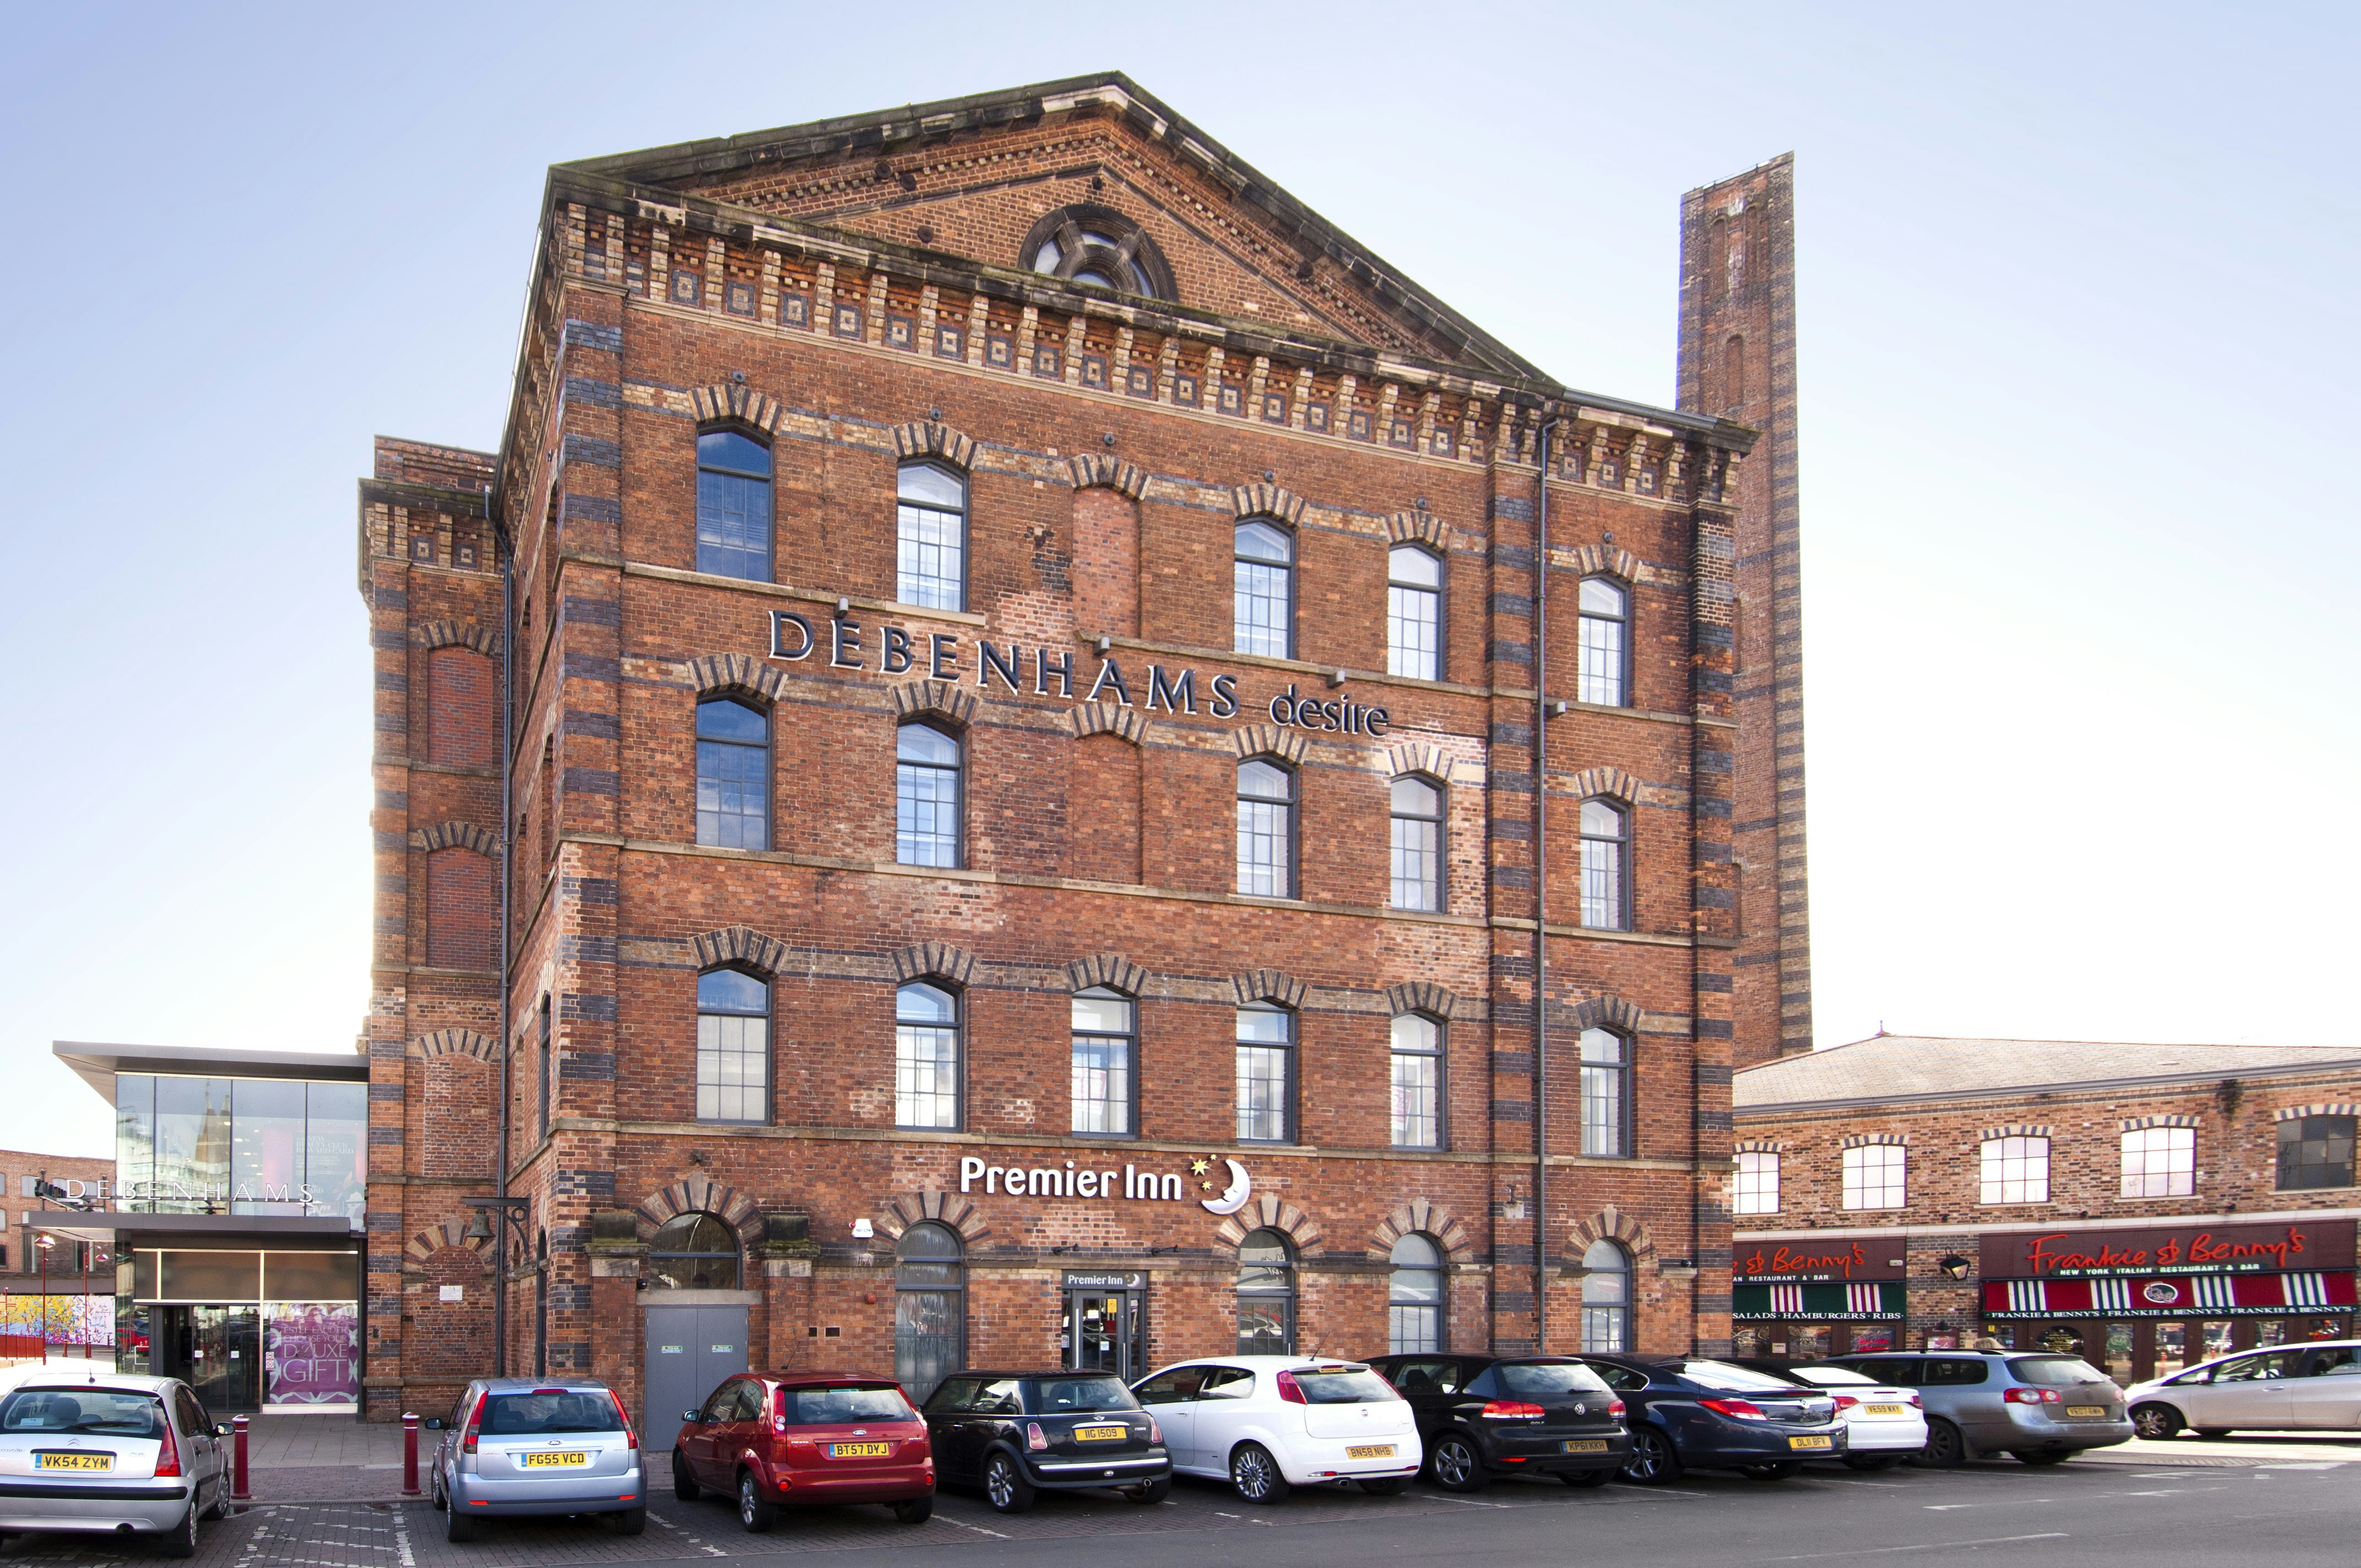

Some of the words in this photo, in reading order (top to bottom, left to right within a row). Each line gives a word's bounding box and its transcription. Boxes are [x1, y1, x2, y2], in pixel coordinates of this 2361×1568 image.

[769, 610, 1240, 719] DEBENHAMS
[1270, 683, 1391, 738] desire
[960, 1157, 1118, 1198] Premier
[1126, 1164, 1182, 1200] Inn
[66, 1179, 313, 1202] DEBENHAMS
[2026, 1233, 2148, 1274] Frankie
[2156, 1237, 2181, 1266] &
[2188, 1226, 2306, 1267] Benny's
[1746, 1250, 1765, 1275] &
[1771, 1242, 1866, 1278] Benny's
[1068, 1275, 1107, 1284] Premier
[1108, 1276, 1123, 1285] Inn
[283, 1359, 347, 1382] GIFT
[1098, 1428, 1118, 1438] 1509
[1568, 1442, 1588, 1450] KP61
[1590, 1441, 1605, 1450] KKH
[1797, 1438, 1811, 1447] DL11
[1813, 1438, 1826, 1446] BFV
[836, 1444, 864, 1455] BT57
[867, 1444, 887, 1454] DYJ
[1350, 1447, 1373, 1457] BN58
[1374, 1446, 1391, 1456] NHB
[43, 1456, 79, 1468] VK54
[82, 1457, 109, 1469] ZYM
[529, 1454, 559, 1464] FG55
[562, 1453, 585, 1463] VCD
